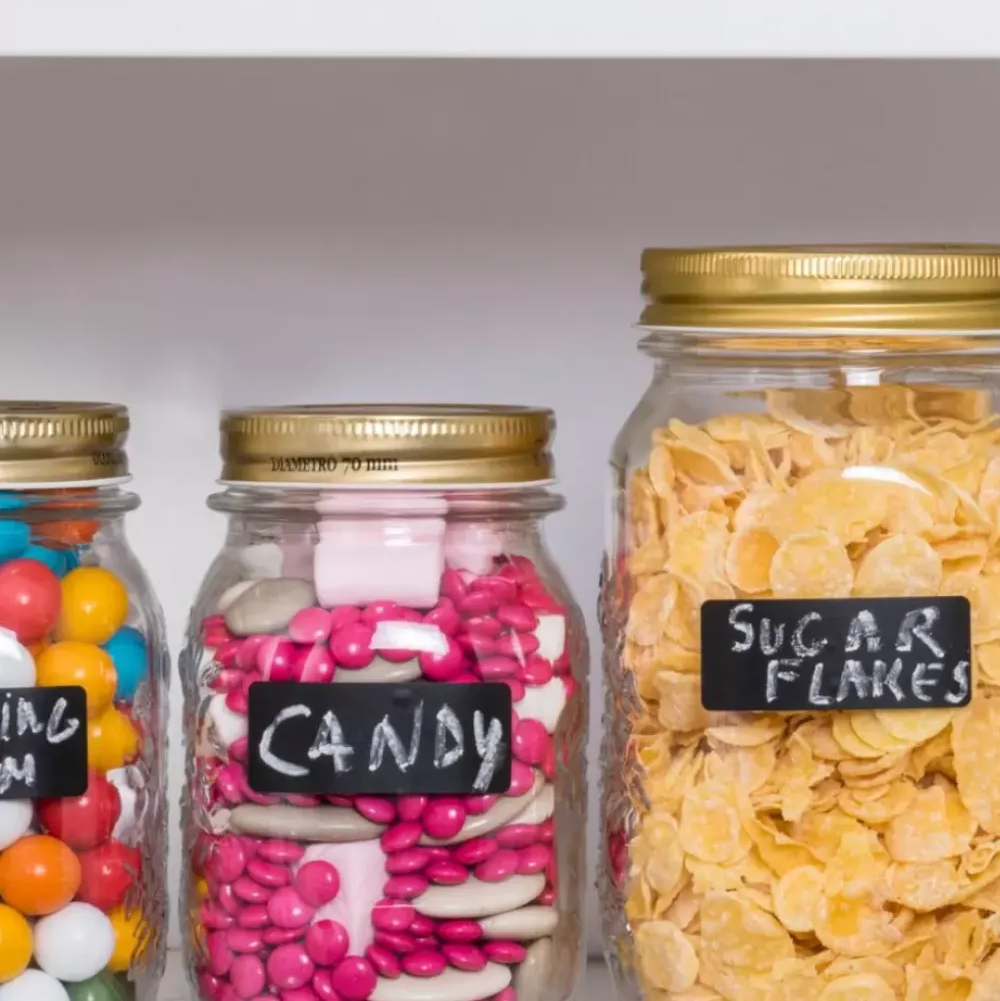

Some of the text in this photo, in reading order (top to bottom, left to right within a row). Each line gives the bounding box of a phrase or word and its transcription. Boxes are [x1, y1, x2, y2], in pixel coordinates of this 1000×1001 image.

[270, 456, 399, 476] DIAMETRO 70 mm
[728, 603, 945, 658] SUGAR
[763, 657, 970, 705] FLAKES
[259, 699, 507, 793] CANDY
